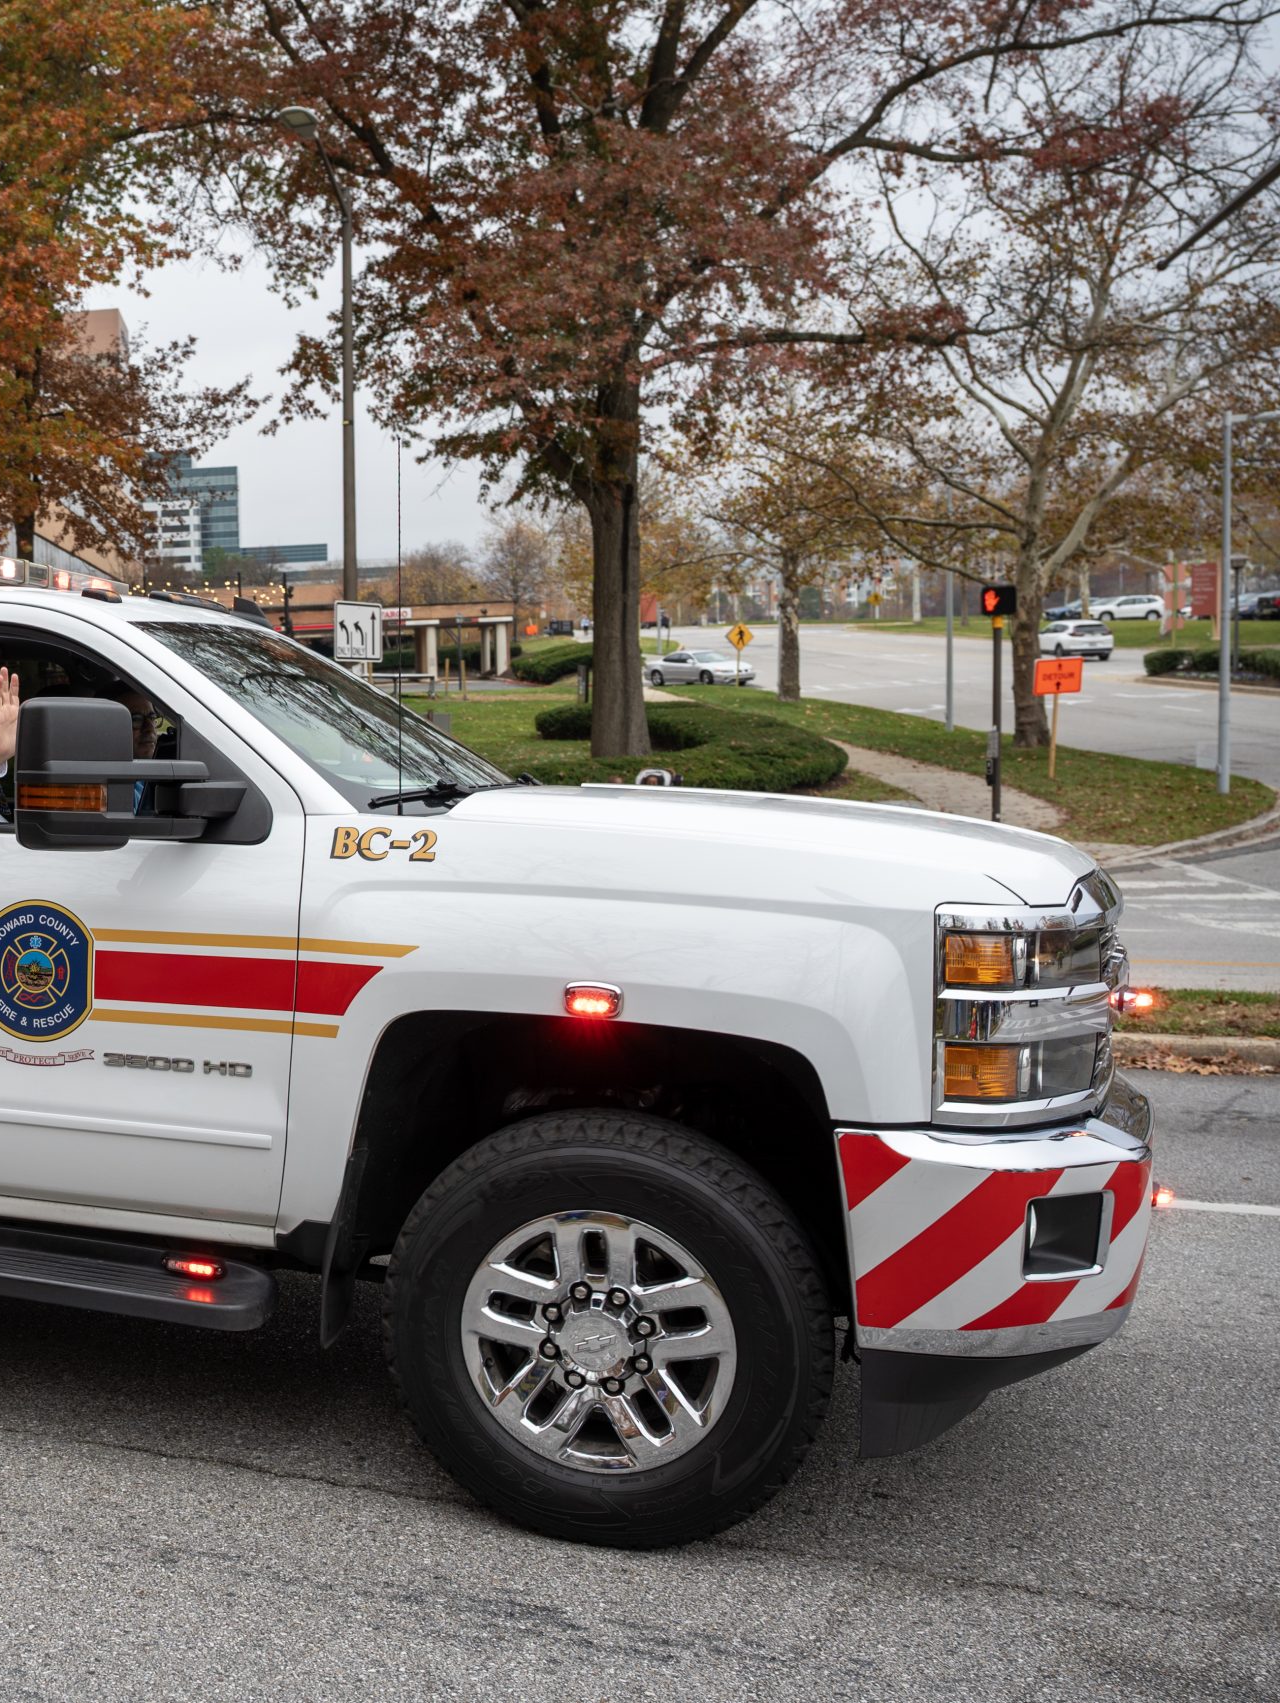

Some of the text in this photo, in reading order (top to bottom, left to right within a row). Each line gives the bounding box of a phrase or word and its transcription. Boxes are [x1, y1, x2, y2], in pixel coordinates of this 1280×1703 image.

[337, 647, 366, 656] ONLY ONLY
[1042, 672, 1075, 681] DETOUR
[330, 827, 437, 862] BC-2
[39, 914, 80, 947] COUNTY
[20, 1016, 28, 1027] &
[33, 1003, 75, 1029] RESCUE
[13, 1054, 57, 1065] PROTECT
[68, 1051, 86, 1060] SERVE
[203, 1060, 253, 1078] HD
